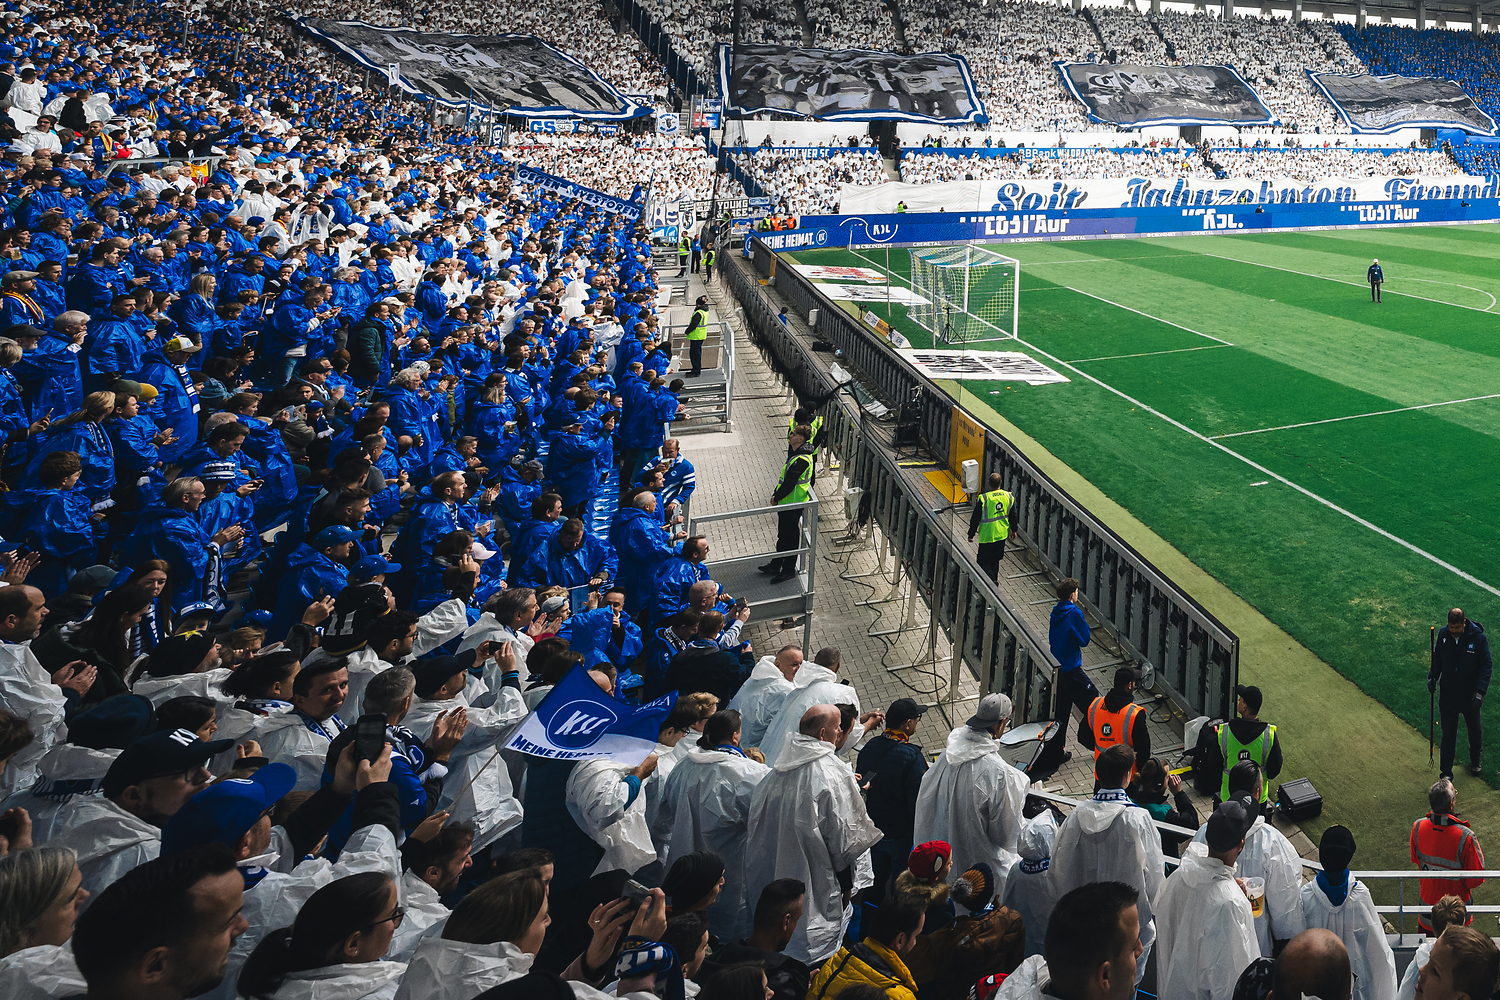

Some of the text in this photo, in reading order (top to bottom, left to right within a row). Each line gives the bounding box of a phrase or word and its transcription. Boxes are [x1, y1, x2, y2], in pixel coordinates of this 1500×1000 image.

[717, 200, 748, 209] YOUNG
[554, 709, 611, 736] KSC
[511, 734, 557, 758] MEINE
